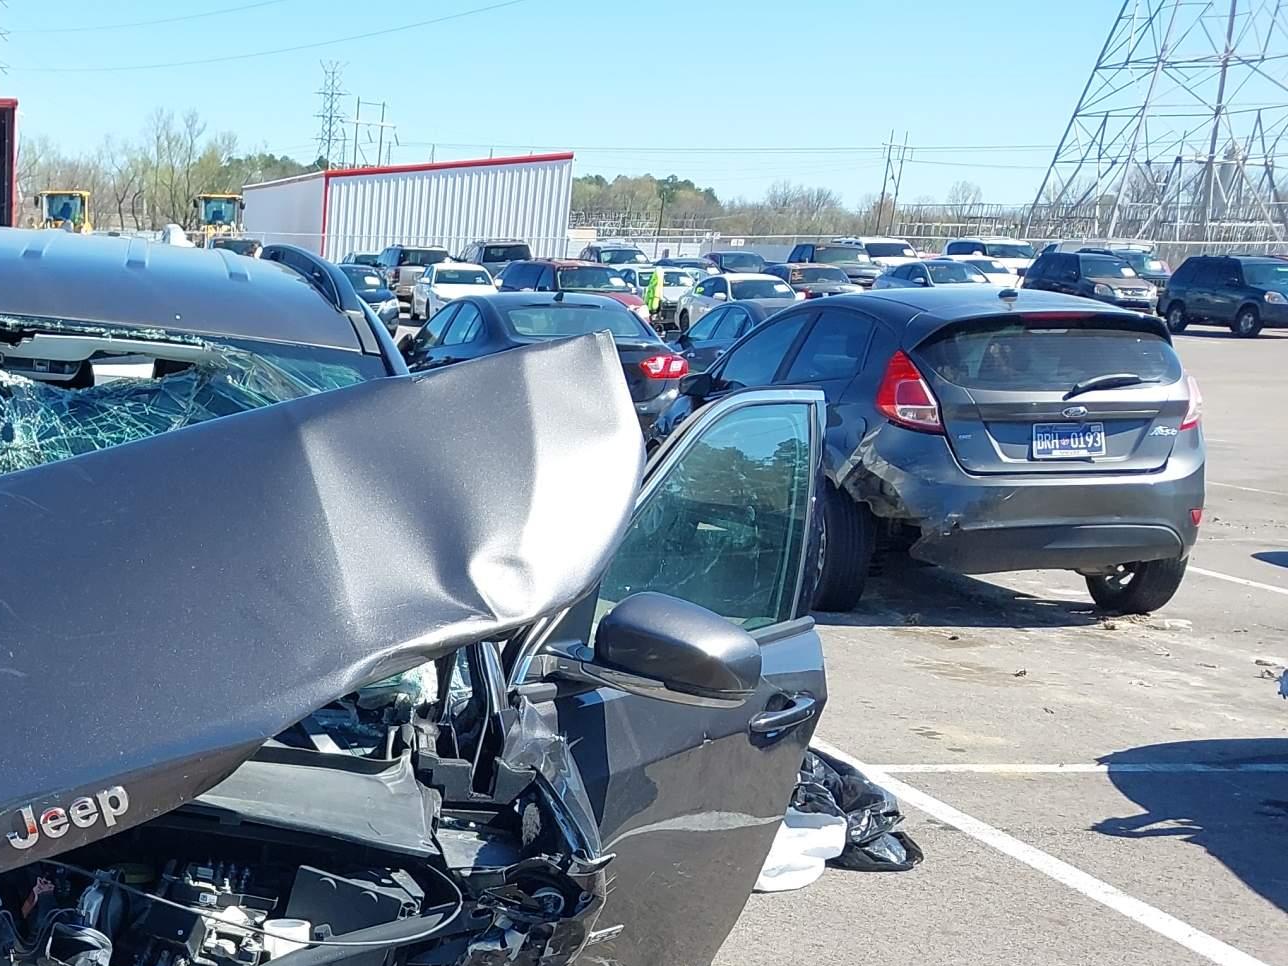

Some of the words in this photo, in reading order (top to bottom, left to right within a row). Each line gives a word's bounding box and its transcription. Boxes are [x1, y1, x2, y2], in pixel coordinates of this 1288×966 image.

[1037, 432, 1059, 450] BRH
[1070, 431, 1101, 448] 0193
[6, 786, 129, 849] Jeep
